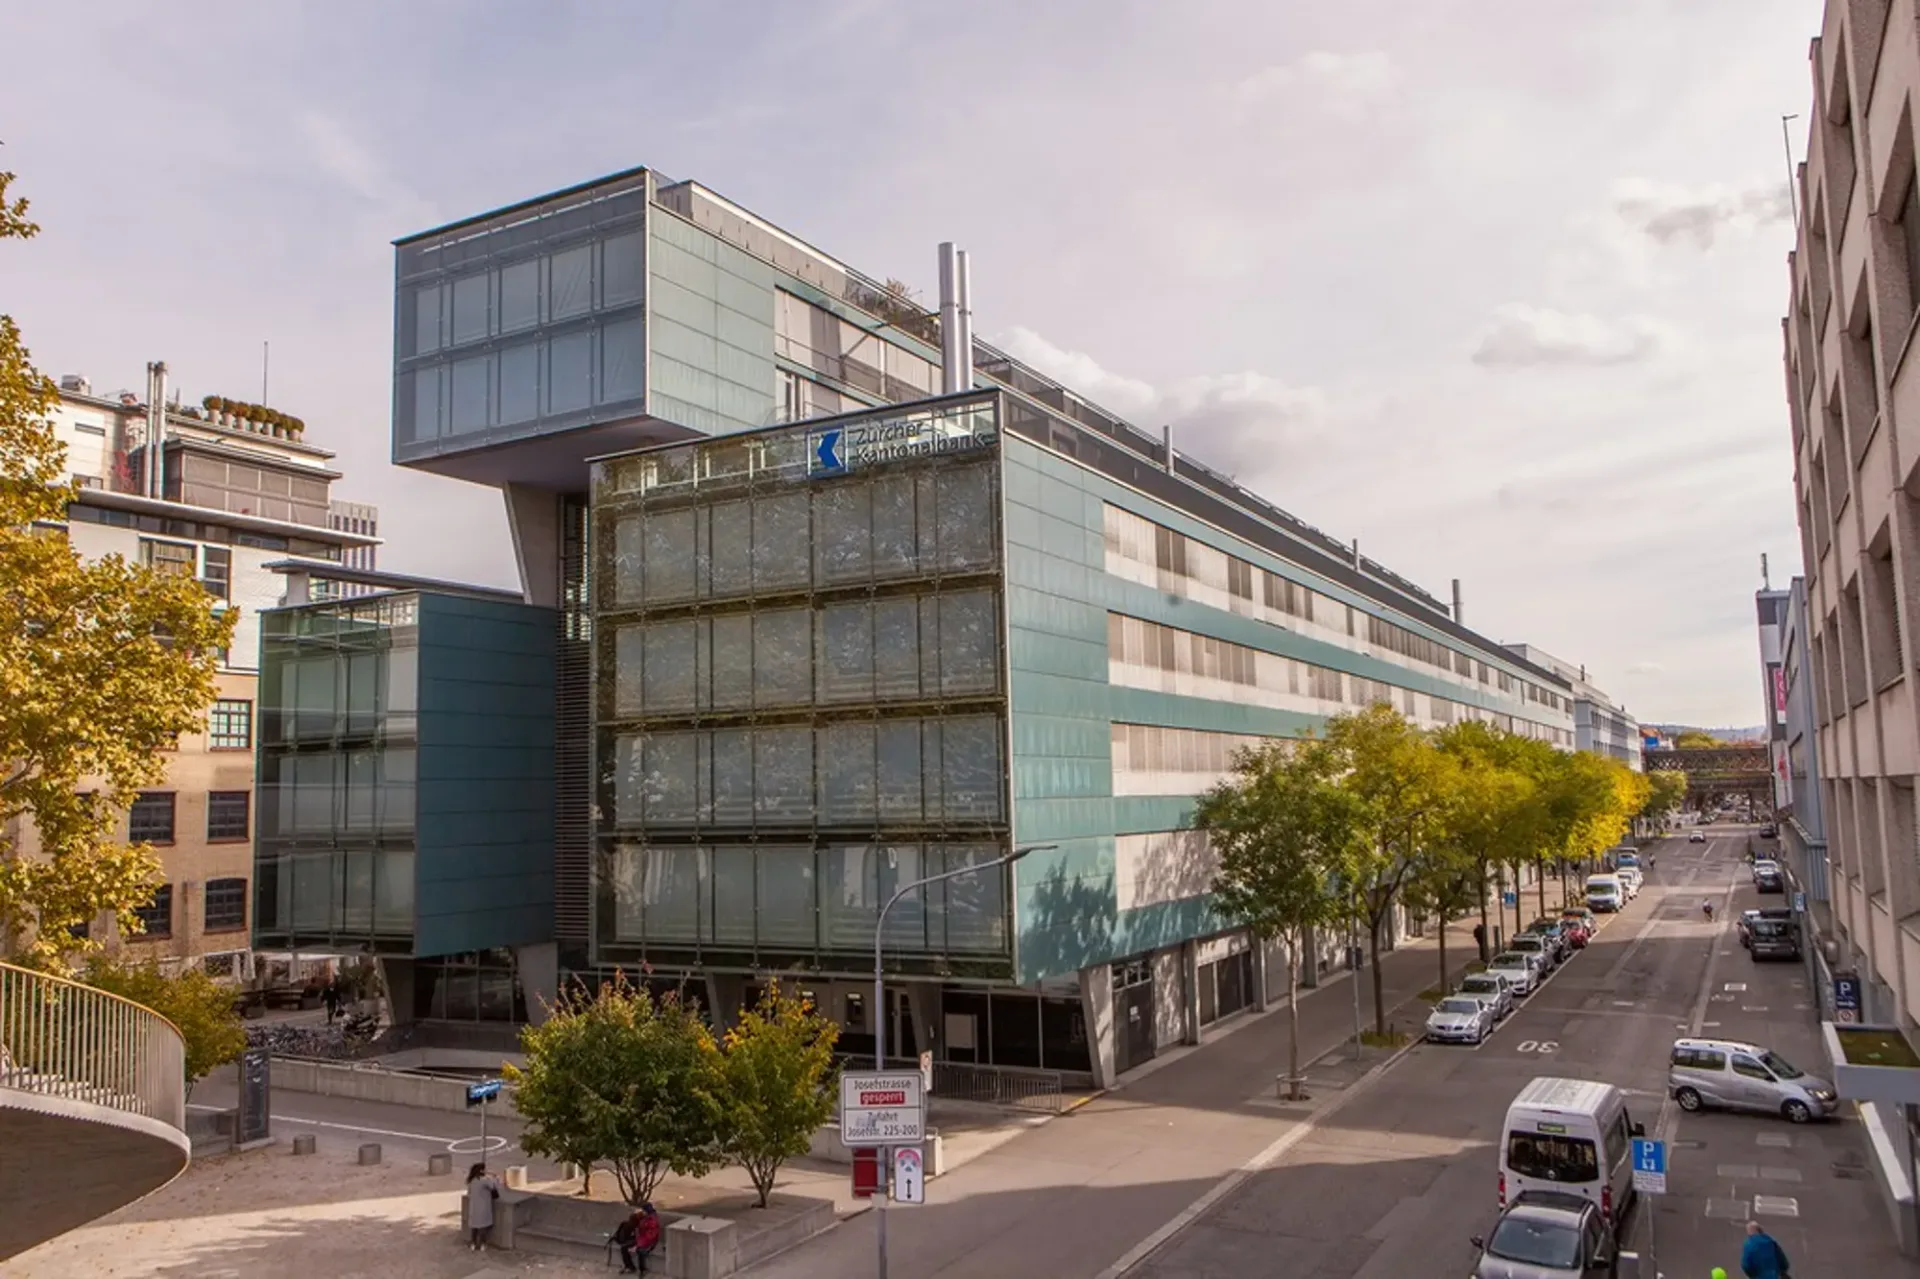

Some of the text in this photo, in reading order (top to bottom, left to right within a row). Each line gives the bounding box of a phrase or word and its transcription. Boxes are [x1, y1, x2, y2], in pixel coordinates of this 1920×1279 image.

[856, 428, 986, 464] Kantonalbank
[1840, 982, 1851, 995] P
[853, 1079, 912, 1091] Josefstrasse
[862, 1092, 903, 1105] gesperrt
[1643, 1141, 1655, 1157] P
